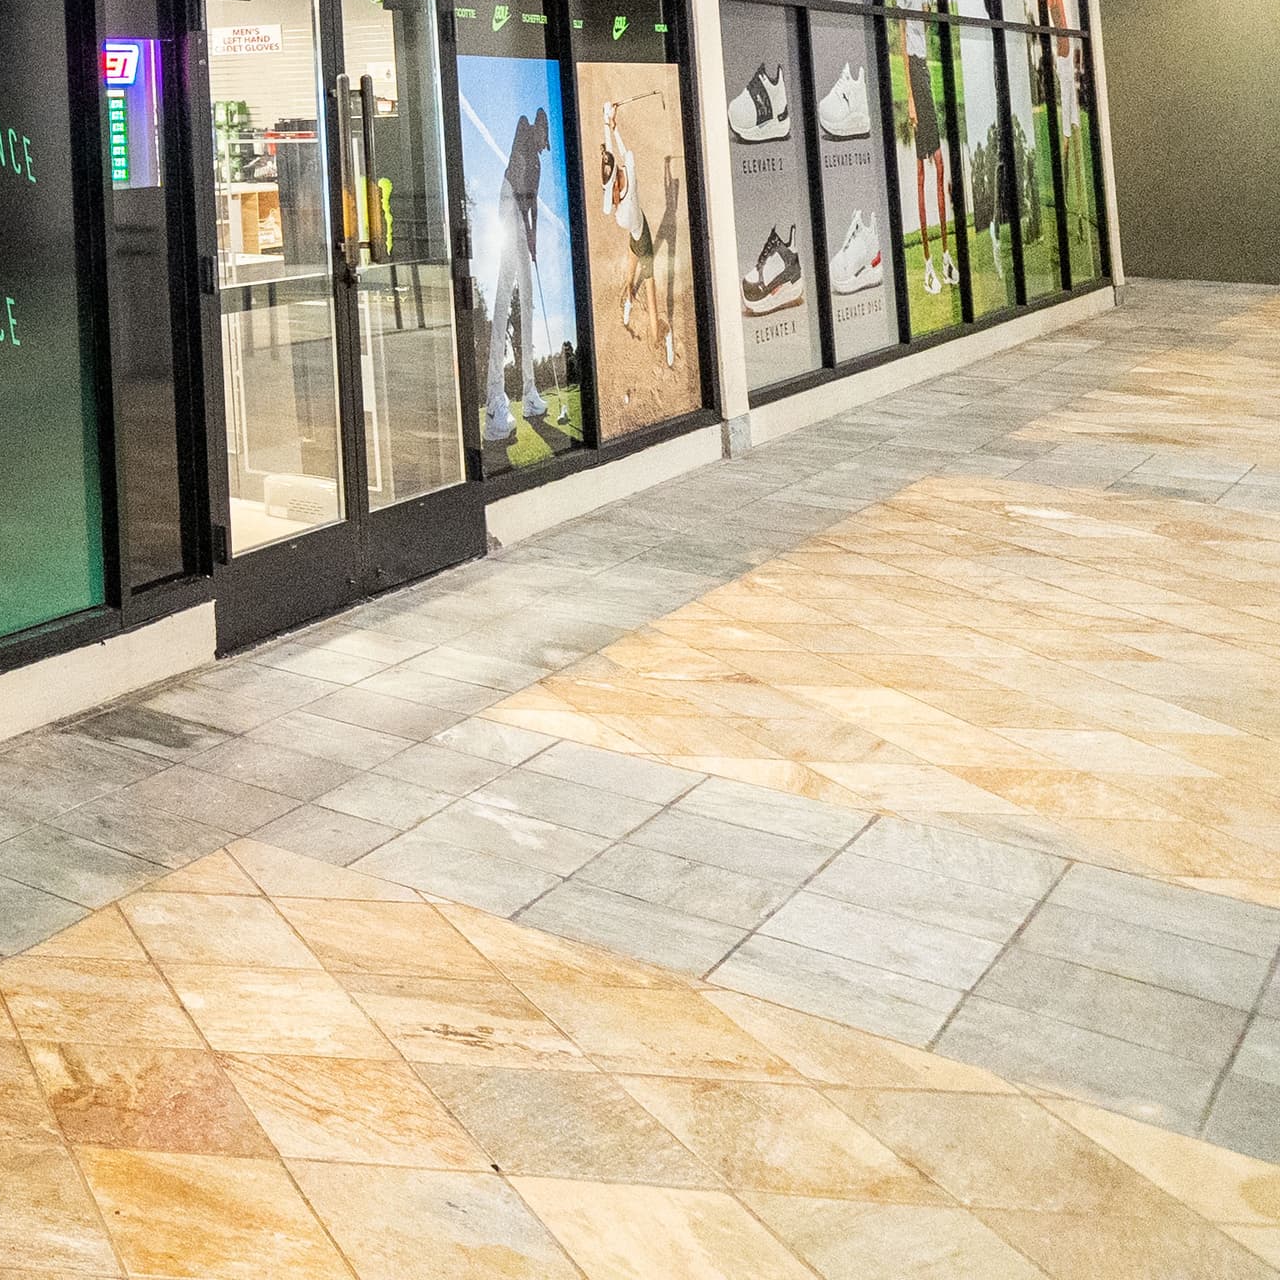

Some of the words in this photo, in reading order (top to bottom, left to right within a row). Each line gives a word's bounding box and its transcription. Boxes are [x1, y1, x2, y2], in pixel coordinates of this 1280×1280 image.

[223, 36, 242, 45] LEFT
[244, 35, 270, 43] HAND
[232, 28, 260, 36] MEN'S
[245, 43, 280, 52] GLOVES
[742, 158, 776, 174] ELEVATE
[777, 157, 784, 171] 2
[824, 154, 853, 169] ELEVATE
[854, 152, 871, 165] TOUR
[837, 303, 866, 323] ELEVATE
[755, 324, 790, 344] ELEVATE
